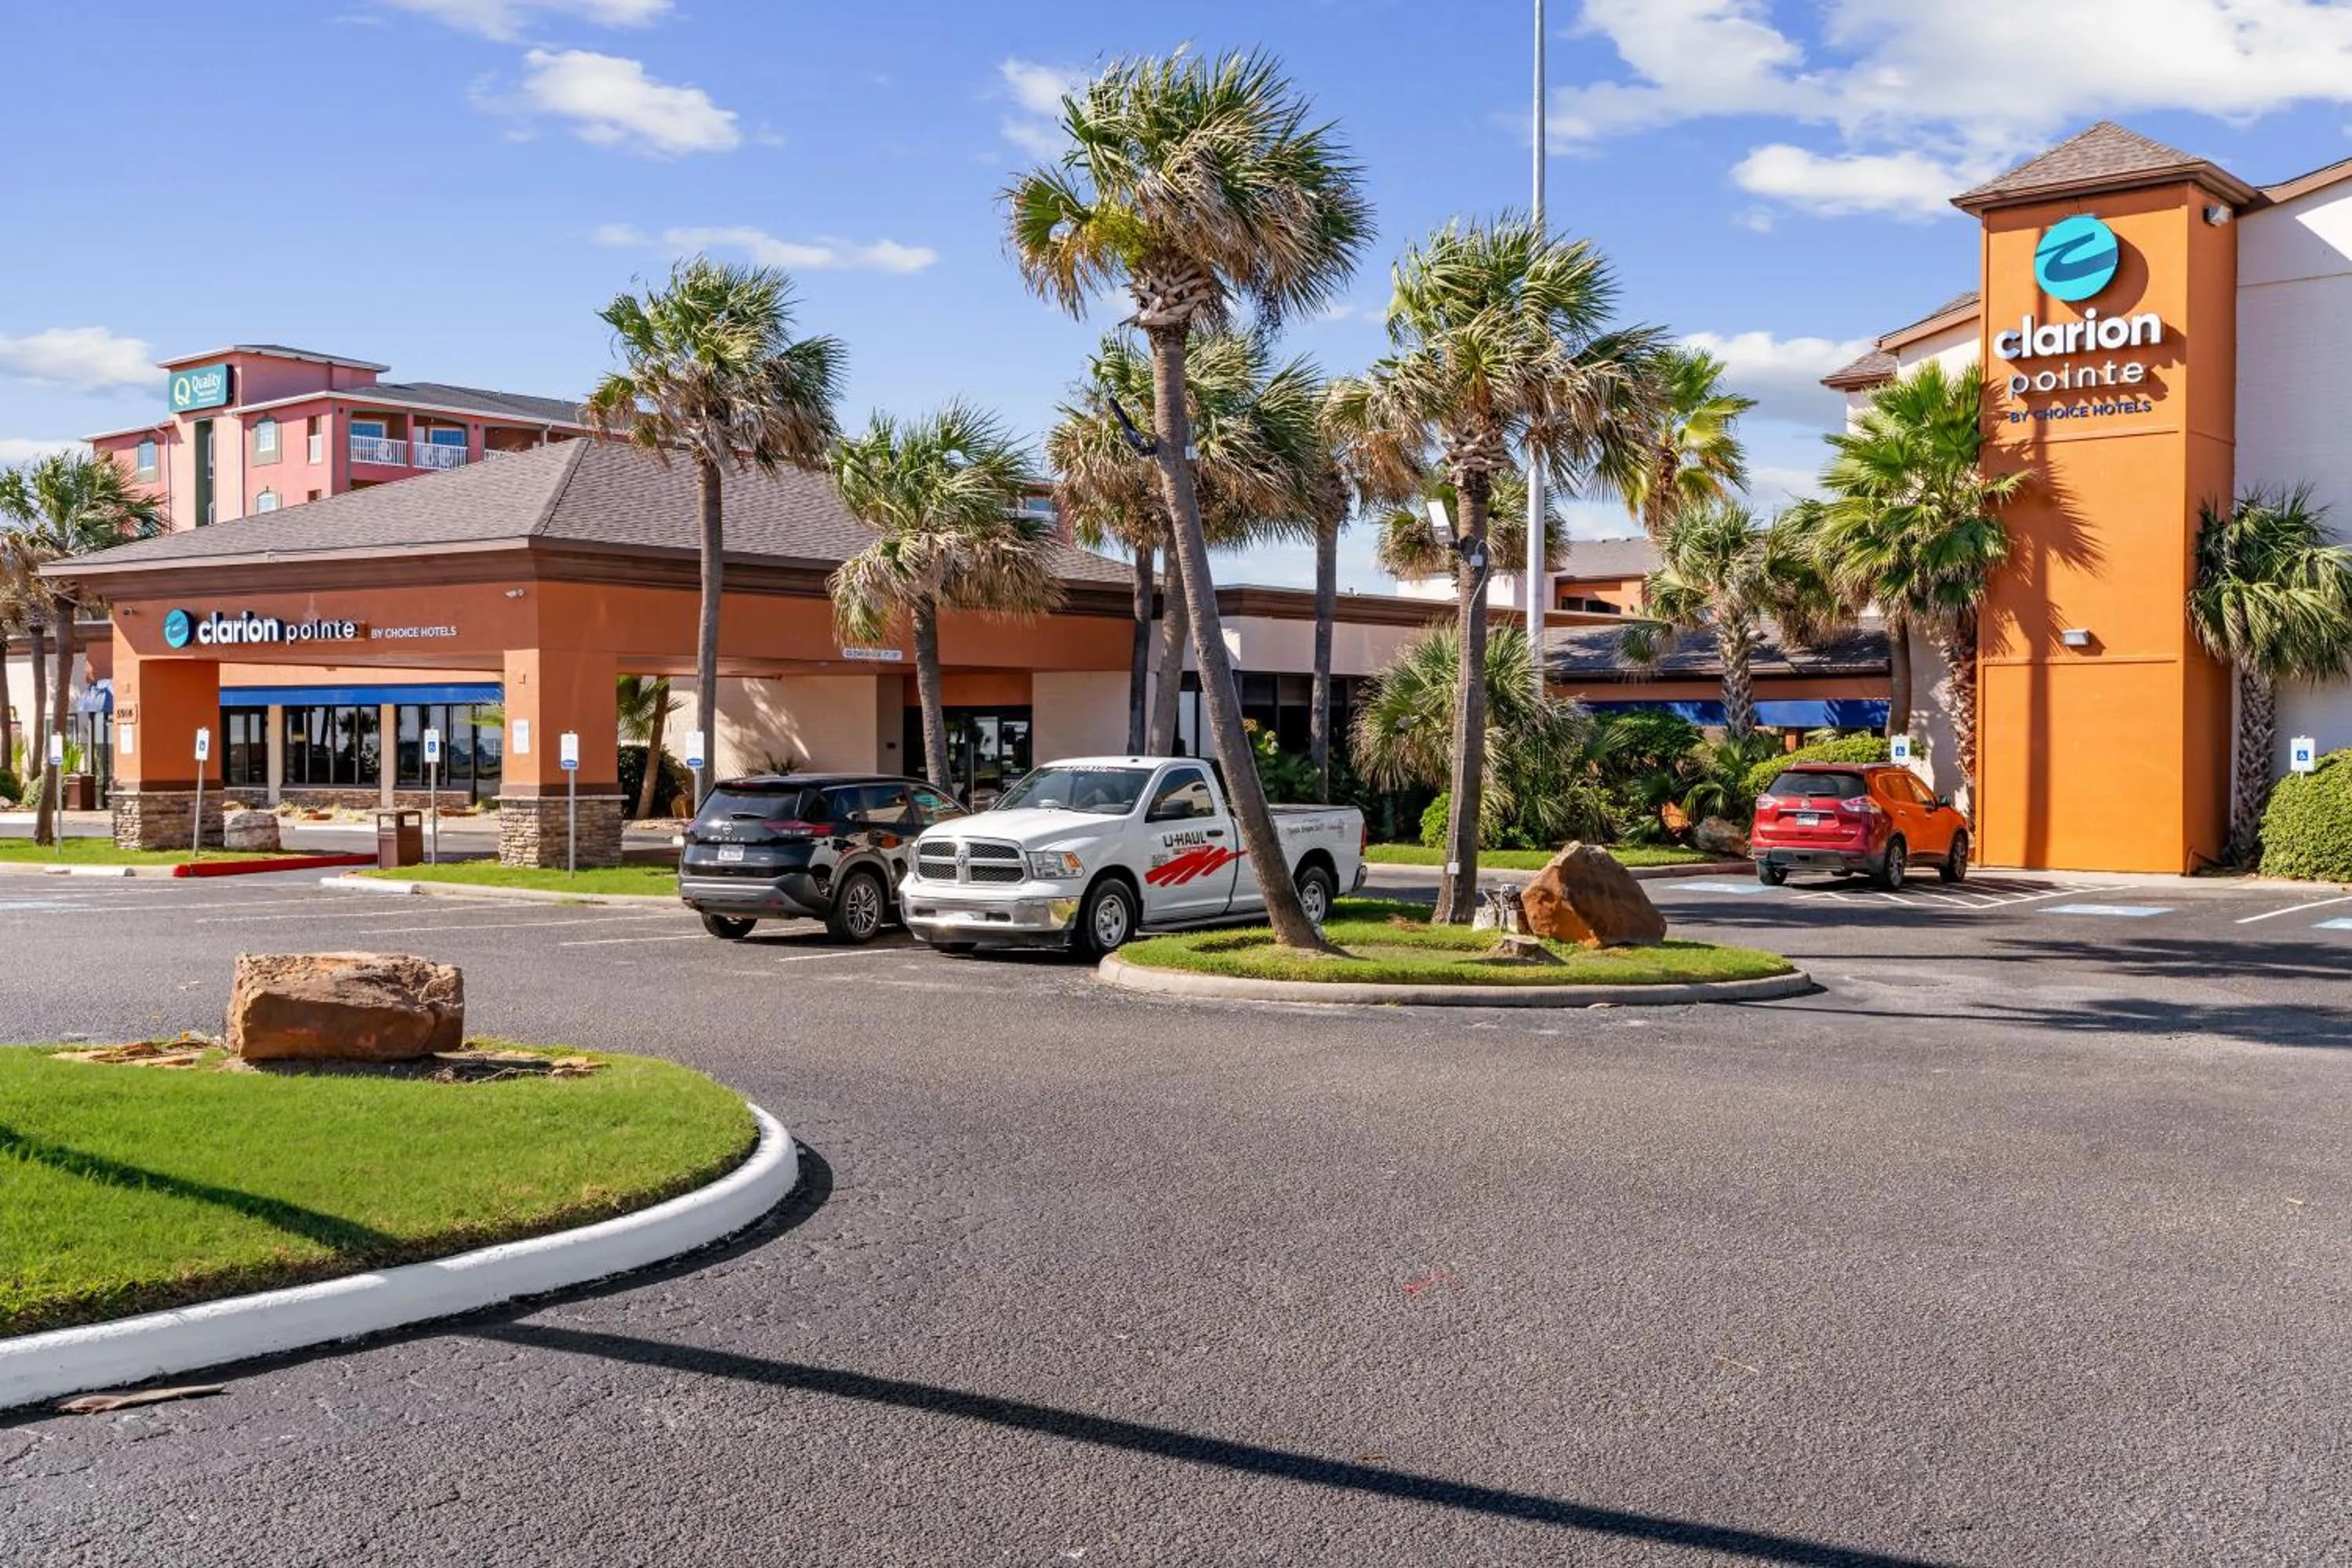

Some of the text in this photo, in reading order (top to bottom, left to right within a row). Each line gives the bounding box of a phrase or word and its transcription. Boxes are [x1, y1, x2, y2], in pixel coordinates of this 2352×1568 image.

[1994, 307, 2161, 360] clarion
[192, 373, 222, 394] Quality
[2009, 360, 2144, 400] pointe
[2009, 401, 2152, 423] BY CHOICE HOTELS
[198, 611, 457, 644] clarion pointe BY CHOICE HOTELS
